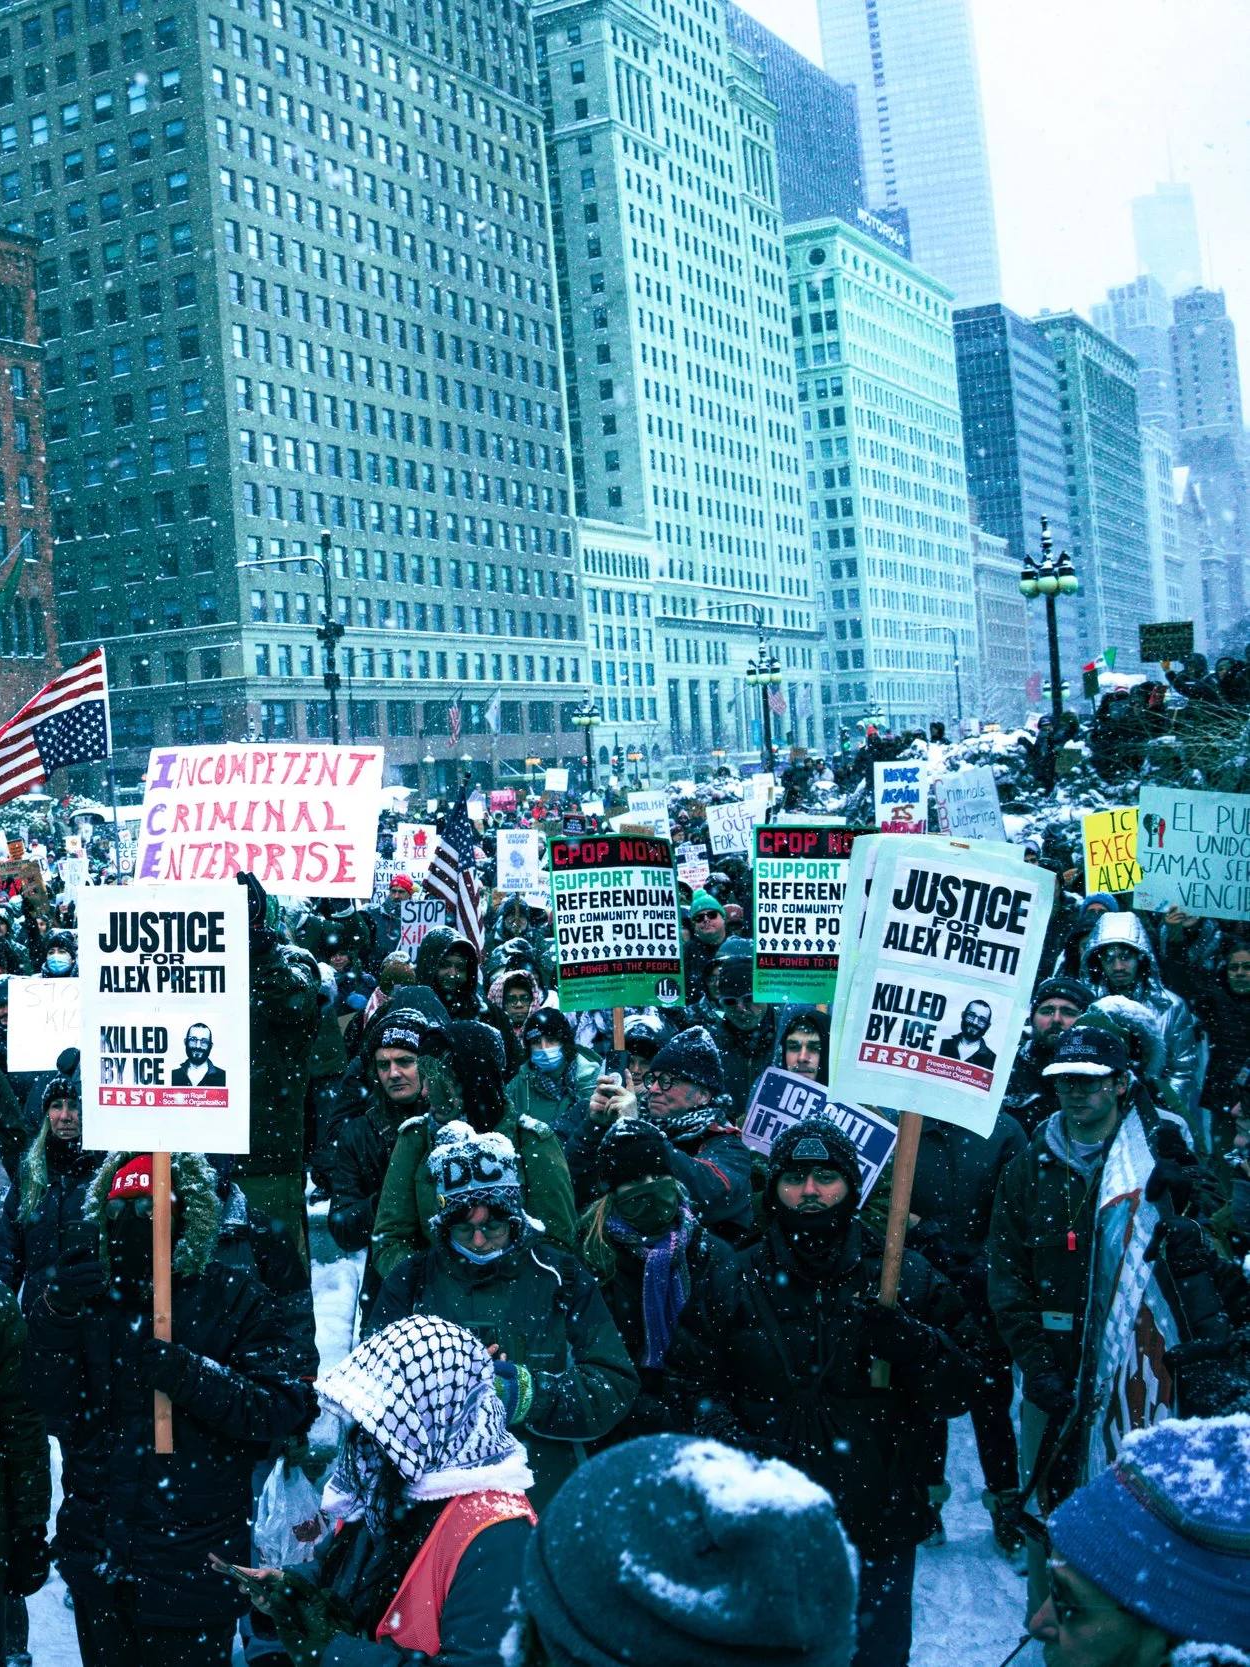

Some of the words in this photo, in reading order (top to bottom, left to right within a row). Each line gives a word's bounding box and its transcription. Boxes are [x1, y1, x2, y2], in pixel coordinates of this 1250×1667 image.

[150, 752, 376, 790] INCOMPETENT
[884, 767, 920, 784] NEVER
[632, 800, 665, 812] ABOLISH
[712, 803, 749, 822] ICE
[891, 804, 914, 822] IS
[146, 800, 346, 836] CRIMINAL
[722, 816, 757, 832] OUT
[1173, 802, 1204, 834] EL
[413, 846, 427, 858] ICE
[714, 833, 737, 851] FOR
[759, 832, 817, 853] CPOP
[140, 841, 356, 882] ENTERPRISE
[554, 843, 609, 866] CPOP
[620, 842, 669, 863] NOW!
[758, 862, 840, 880] SUPPORT
[1098, 861, 1135, 893] ALEX
[1142, 851, 1211, 881] JAMAS
[555, 870, 634, 891] SUPPORT
[640, 868, 672, 888] THE
[556, 890, 676, 911] REFERENDUM
[758, 904, 778, 914] FOR
[782, 904, 844, 914] COMMUNITY
[892, 869, 1032, 936] JUSTICE
[402, 901, 446, 923] STOP
[558, 912, 576, 925] FOR
[580, 910, 638, 924] COMMUNITY
[643, 910, 676, 921] POWER
[98, 910, 226, 953] JUSTICE
[559, 924, 604, 946] OVER
[612, 922, 677, 942] POLICE
[758, 916, 806, 935] OVER
[932, 916, 980, 938] FOR
[139, 953, 184, 965] FOR
[882, 921, 942, 958] ALEX
[944, 931, 1021, 976] PRETTI
[562, 967, 578, 977] ALL
[580, 965, 608, 975] POWER
[614, 963, 624, 972] TO
[626, 962, 642, 972] THE
[646, 962, 679, 972] PEOPLE
[759, 957, 776, 966] ALL
[780, 957, 810, 967] POWER
[814, 958, 825, 967] TO
[99, 966, 151, 993] ALEX
[156, 966, 226, 994] PRETTI
[872, 982, 947, 1022] KILLED
[100, 1026, 168, 1054] KILLED
[864, 1013, 898, 1044] BY
[898, 1019, 937, 1052] ICE
[863, 1046, 920, 1069] FRSO
[926, 1058, 955, 1070] Freedom
[956, 1065, 972, 1076] Road
[100, 1057, 126, 1085] BY
[132, 1057, 164, 1086] ICE
[925, 1066, 952, 1077] Socialist
[952, 1071, 989, 1088] Organization
[102, 1089, 156, 1105] FRSO
[188, 1098, 226, 1106] Organization
[190, 1090, 206, 1100] Road
[442, 1151, 503, 1192] DC
